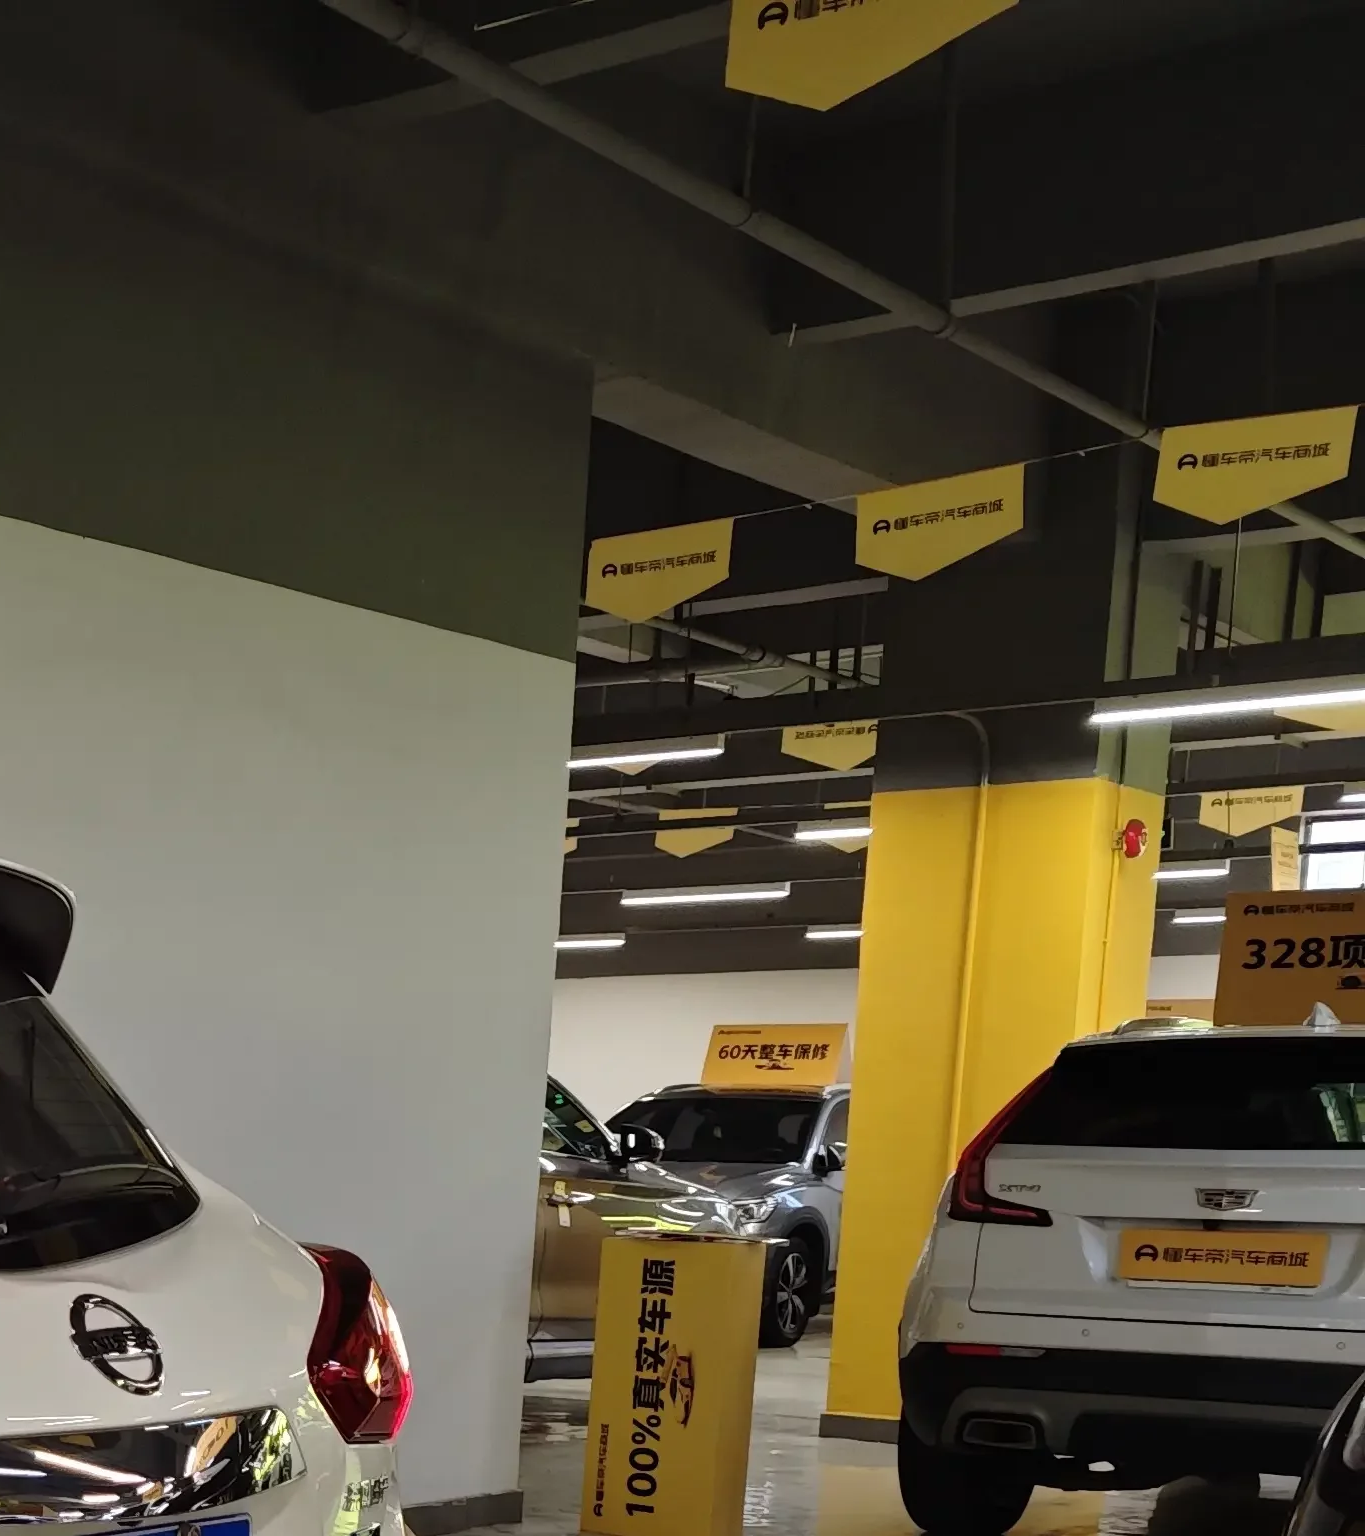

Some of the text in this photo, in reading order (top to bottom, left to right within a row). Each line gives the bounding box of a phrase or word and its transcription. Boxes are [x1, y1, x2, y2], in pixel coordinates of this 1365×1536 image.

[1201, 442, 1332, 468] 懂车帝汽车商城
[894, 498, 1004, 531] 懂车帝汽车商城
[1241, 933, 1365, 970] 328项
[718, 1043, 831, 1061] 60天整车保修
[1163, 1247, 1310, 1269] 懂车帝汽车商城
[625, 1258, 676, 1516] 100%真实车源
